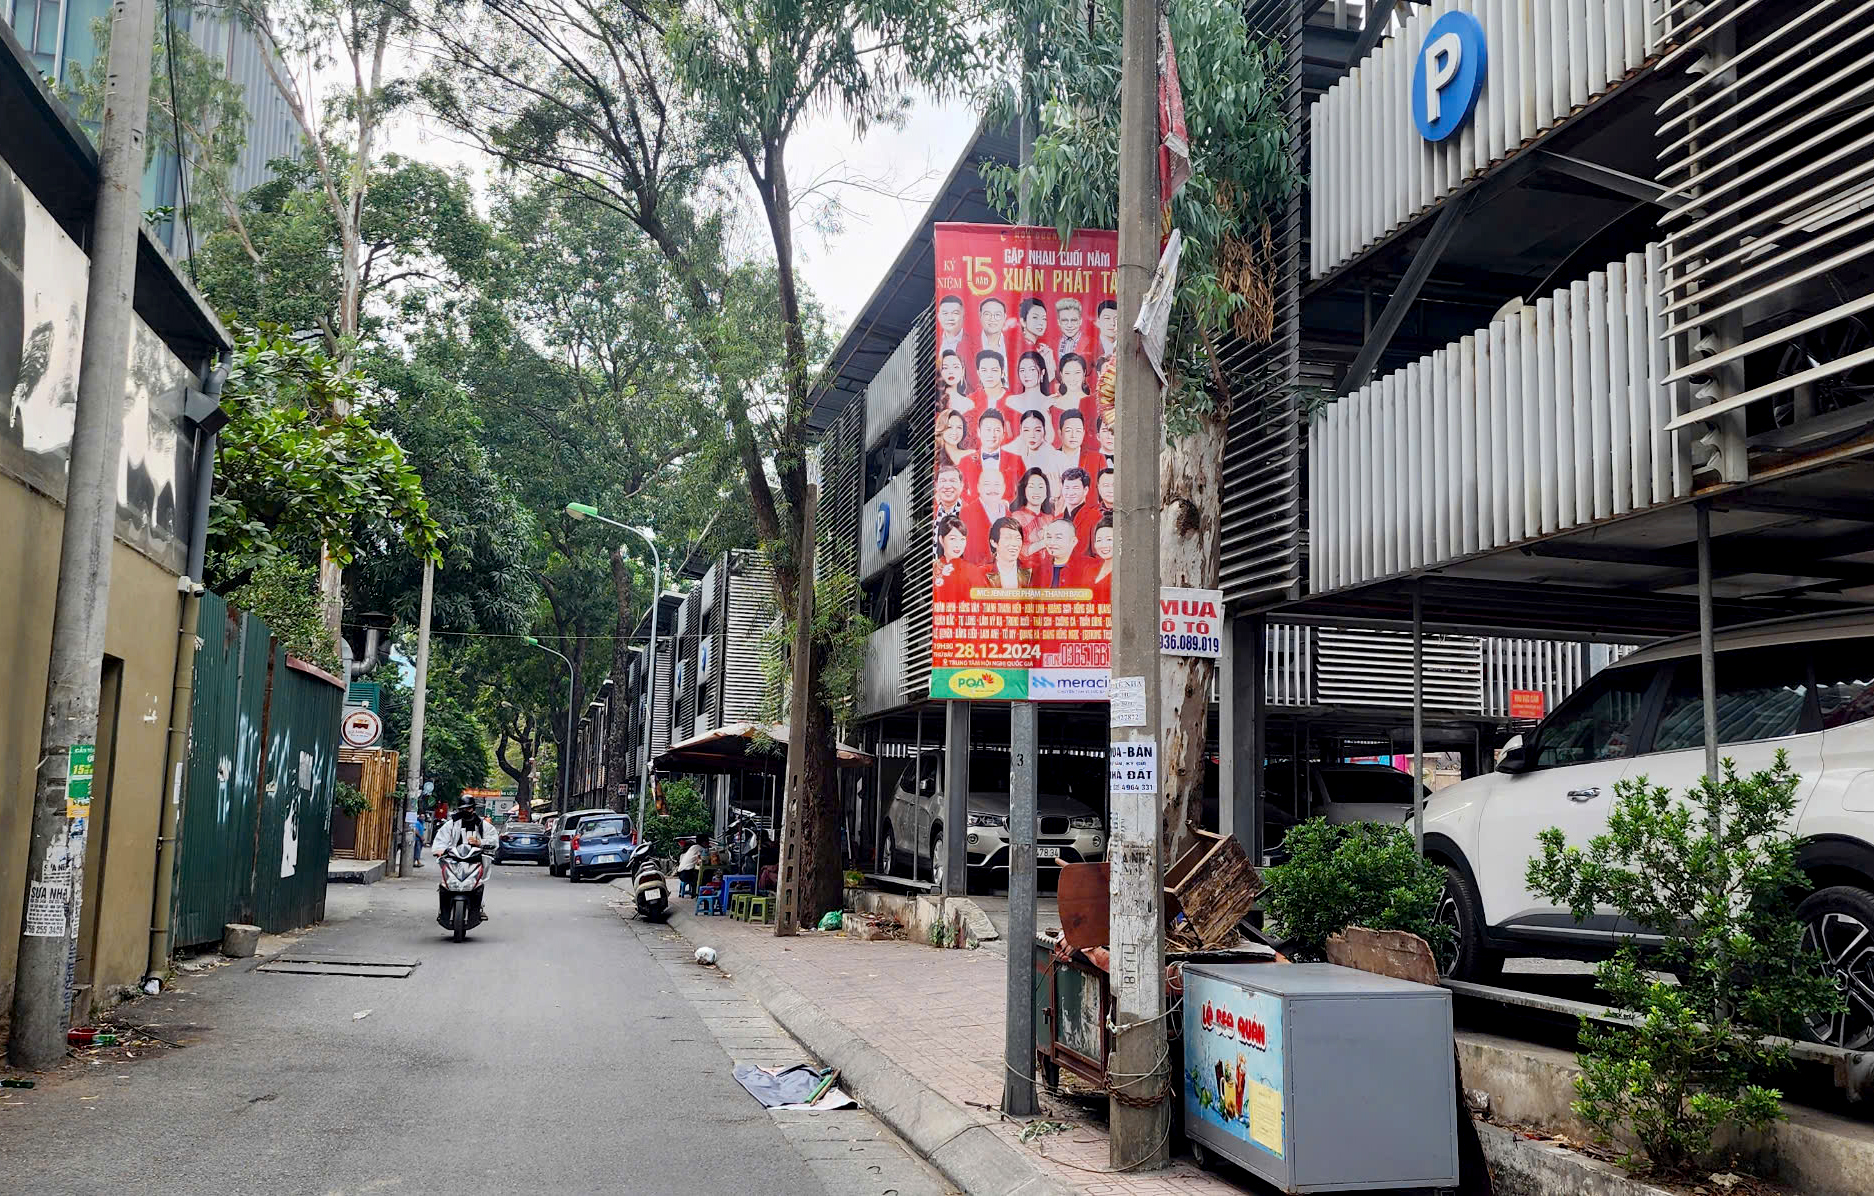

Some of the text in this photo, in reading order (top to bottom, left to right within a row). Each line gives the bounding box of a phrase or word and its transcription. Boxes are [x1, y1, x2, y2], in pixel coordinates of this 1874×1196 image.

[1425, 32, 1462, 123] P
[1004, 246, 1111, 267] GẶP NHAU CUỐI NĂM
[1003, 265, 1045, 292] XUÂN
[1053, 267, 1093, 294] PHÁT
[1161, 618, 1210, 635] Ô TÔ
[954, 643, 1042, 659] 28.12.2024
[1017, 754, 1024, 767] 3
